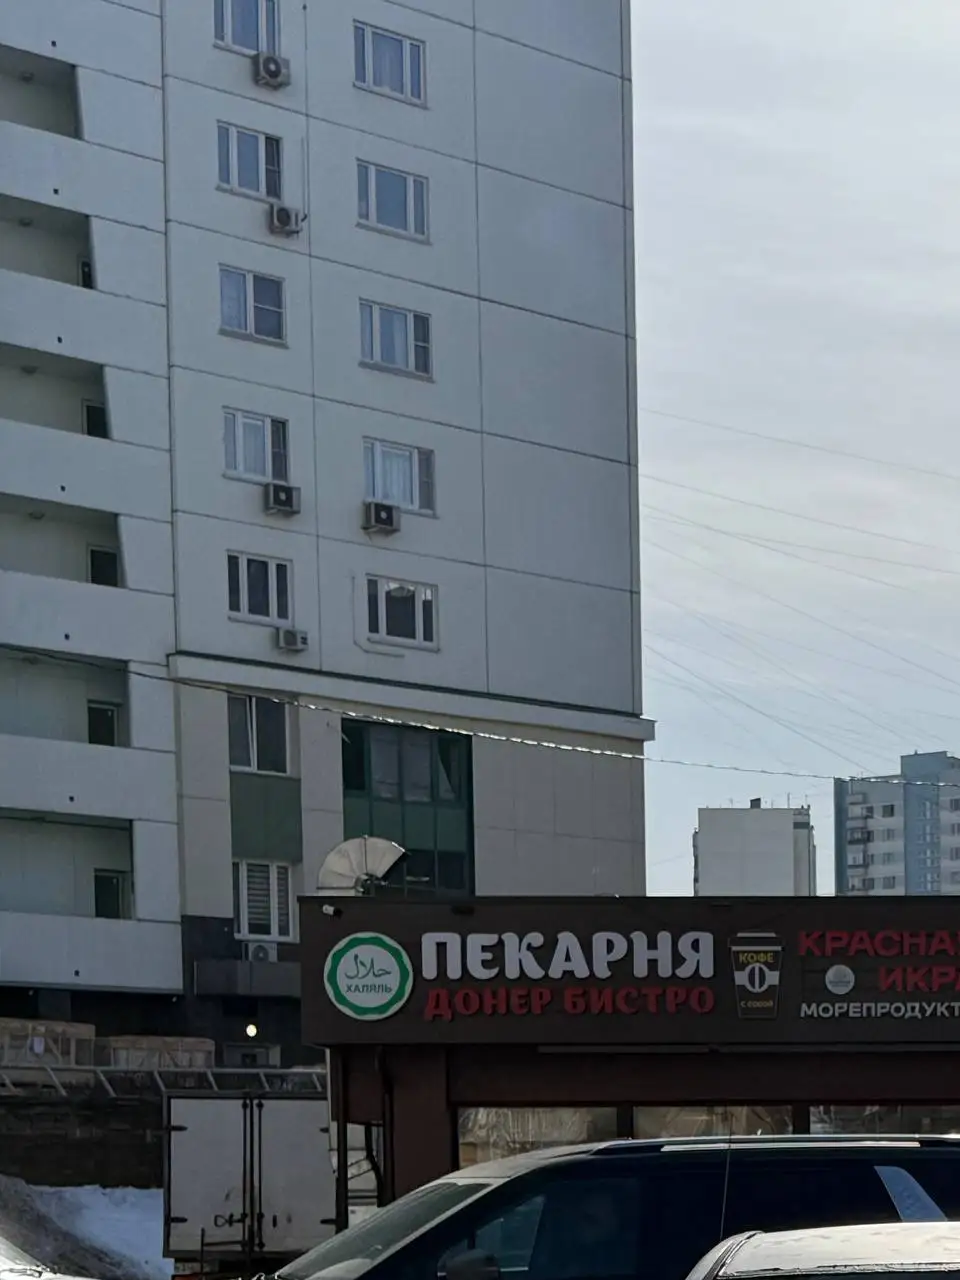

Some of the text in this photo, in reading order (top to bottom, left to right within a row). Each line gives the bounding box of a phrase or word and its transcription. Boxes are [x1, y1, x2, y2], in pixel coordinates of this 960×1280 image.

[344, 953, 392, 980] حلال
[421, 930, 714, 979] ПЕКАРНЯ
[738, 952, 775, 963] КОФЕ
[345, 983, 393, 994] ХАЛЯЛЬ
[424, 985, 715, 1021] ДОНЕР БИСТРО
